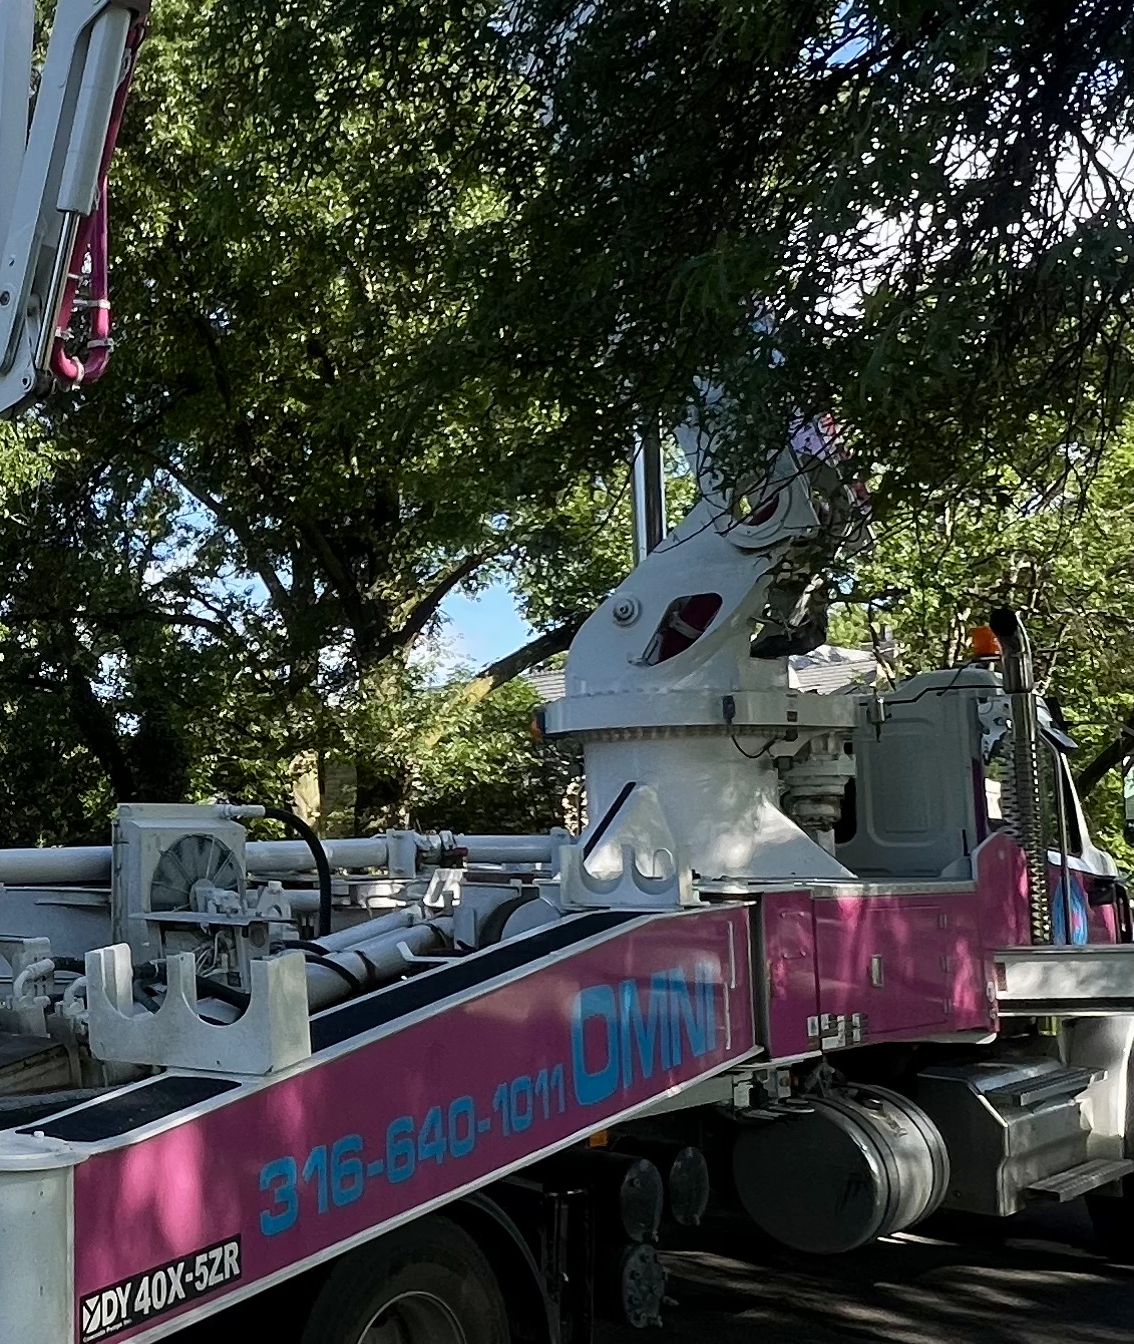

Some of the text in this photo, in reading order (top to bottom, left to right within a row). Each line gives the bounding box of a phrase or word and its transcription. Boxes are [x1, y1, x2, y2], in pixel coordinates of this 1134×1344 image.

[570, 960, 717, 1106] OMNI
[259, 1063, 566, 1237] 316-640-1011
[134, 1241, 241, 1315] 40X-5ZR
